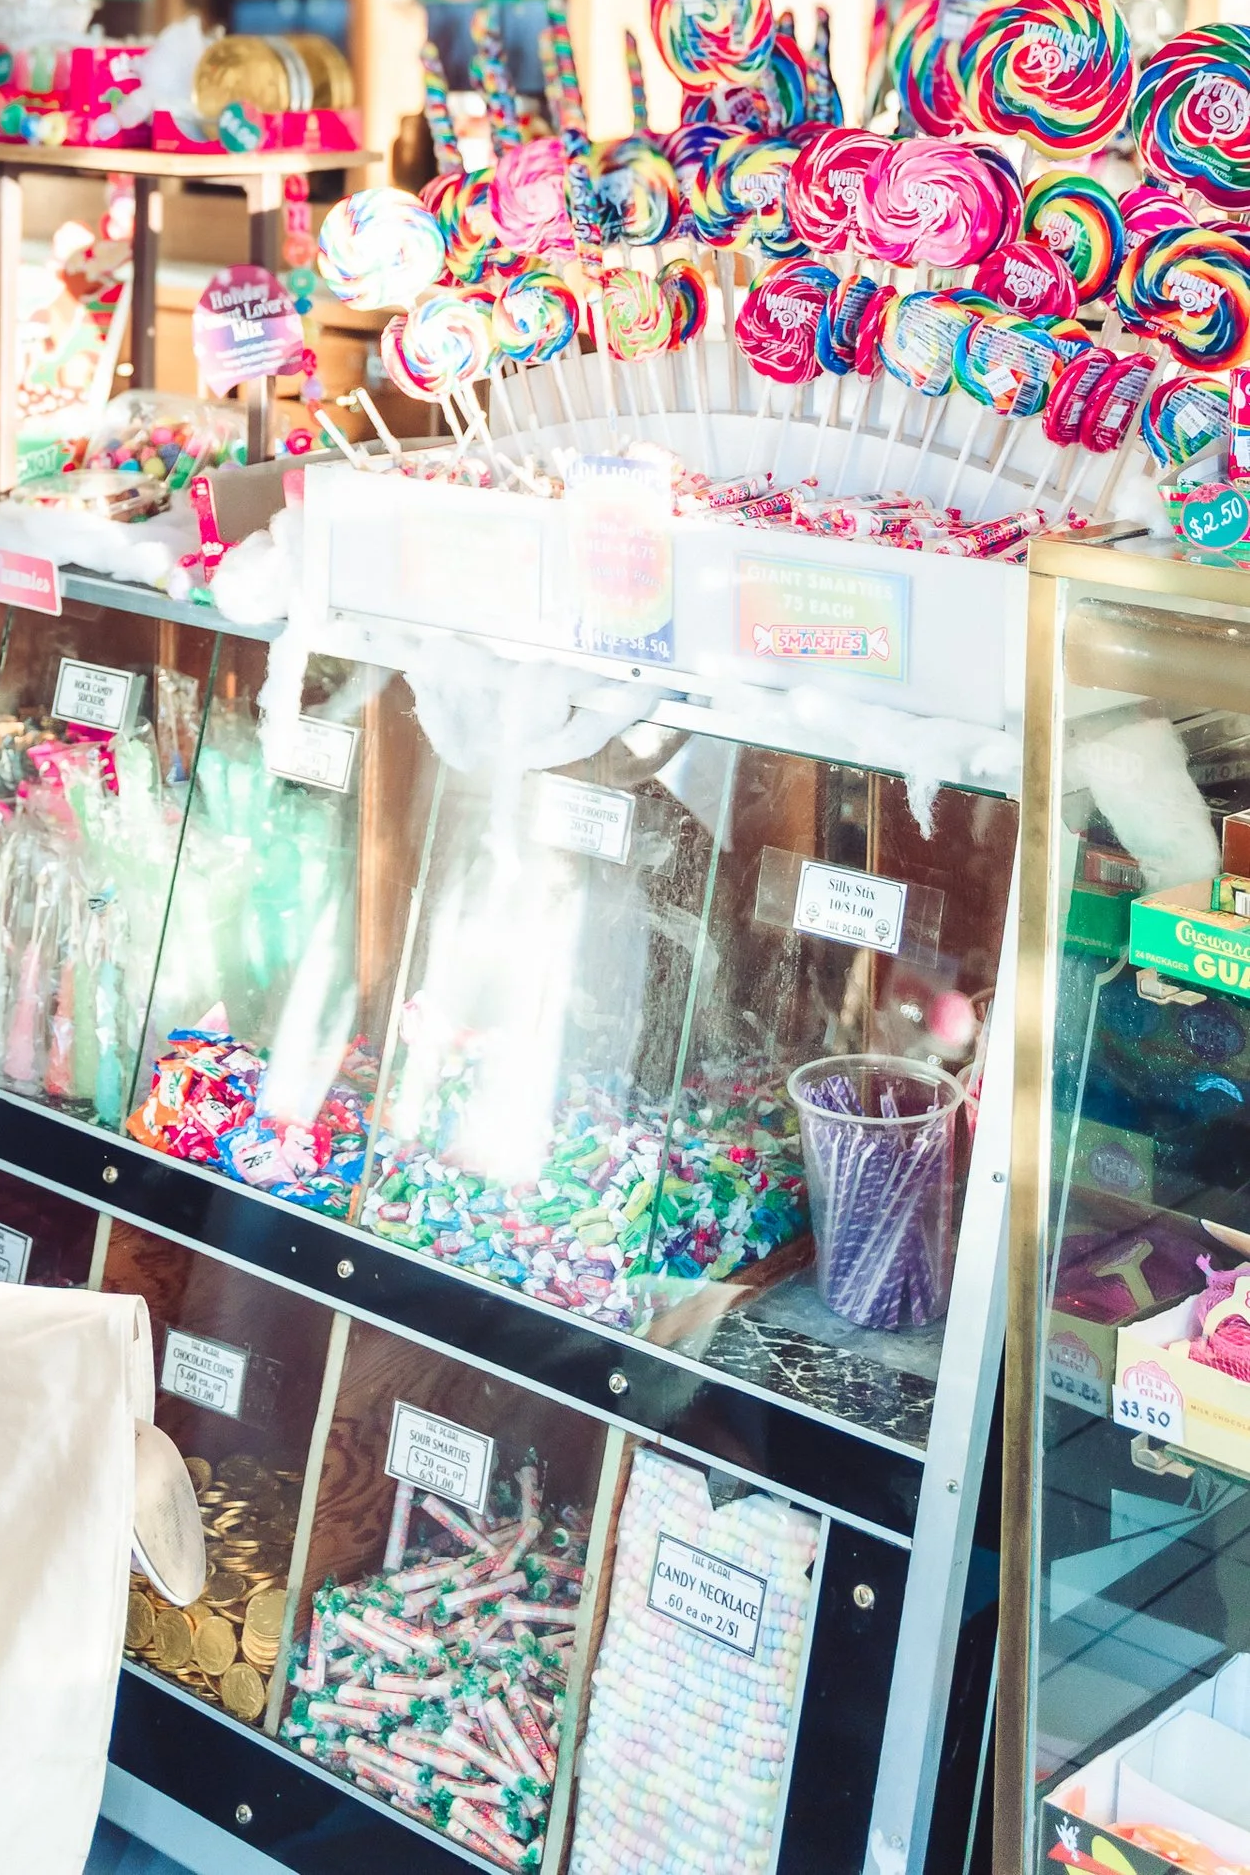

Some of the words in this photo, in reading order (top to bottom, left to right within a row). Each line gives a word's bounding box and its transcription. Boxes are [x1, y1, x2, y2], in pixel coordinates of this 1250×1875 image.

[1024, 20, 1096, 61] WHIRLY
[738, 172, 790, 193] WHIRLY
[833, 186, 857, 205] PO
[1004, 256, 1058, 292] WHIRLY
[1004, 274, 1041, 300] POP
[1165, 266, 1226, 304] WHIRLY
[209, 283, 270, 310] Holiday
[766, 293, 822, 321] WHIRLY
[1168, 285, 1213, 313] POP
[231, 320, 265, 342] Mix
[769, 310, 806, 330] POP
[1189, 497, 1243, 541] $2.50
[747, 565, 803, 589] GIANT
[807, 576, 894, 602] SMARTIES
[809, 598, 855, 620] EACH
[778, 634, 862, 650] SMARTIES
[828, 878, 851, 897] Silly
[855, 884, 875, 900] Stix
[829, 898, 874, 918] 10/$1.00
[842, 923, 867, 939] PEARL
[1135, 950, 1145, 959] 24
[1145, 953, 1190, 973] PACKAGES
[173, 1347, 212, 1371] CHOCOLATE
[213, 1363, 235, 1380] COINS
[1119, 1400, 1171, 1428] $3.50
[1190, 1404, 1210, 1417] MILK
[1212, 1411, 1250, 1431] CHOCOL
[410, 1429, 431, 1446] SOUR
[432, 1438, 471, 1463] SMARTIES
[414, 1451, 434, 1469] $.20
[452, 1470, 464, 1481] or
[419, 1469, 454, 1491] 6/$1.00
[691, 1553, 705, 1568] THE
[707, 1560, 732, 1581] PEARL
[657, 1561, 697, 1591] CANDY
[698, 1580, 759, 1622] NECKLACE
[664, 1593, 684, 1611] .60
[686, 1605, 698, 1619] ea
[700, 1612, 713, 1625] or
[715, 1615, 739, 1638] 2/$1
